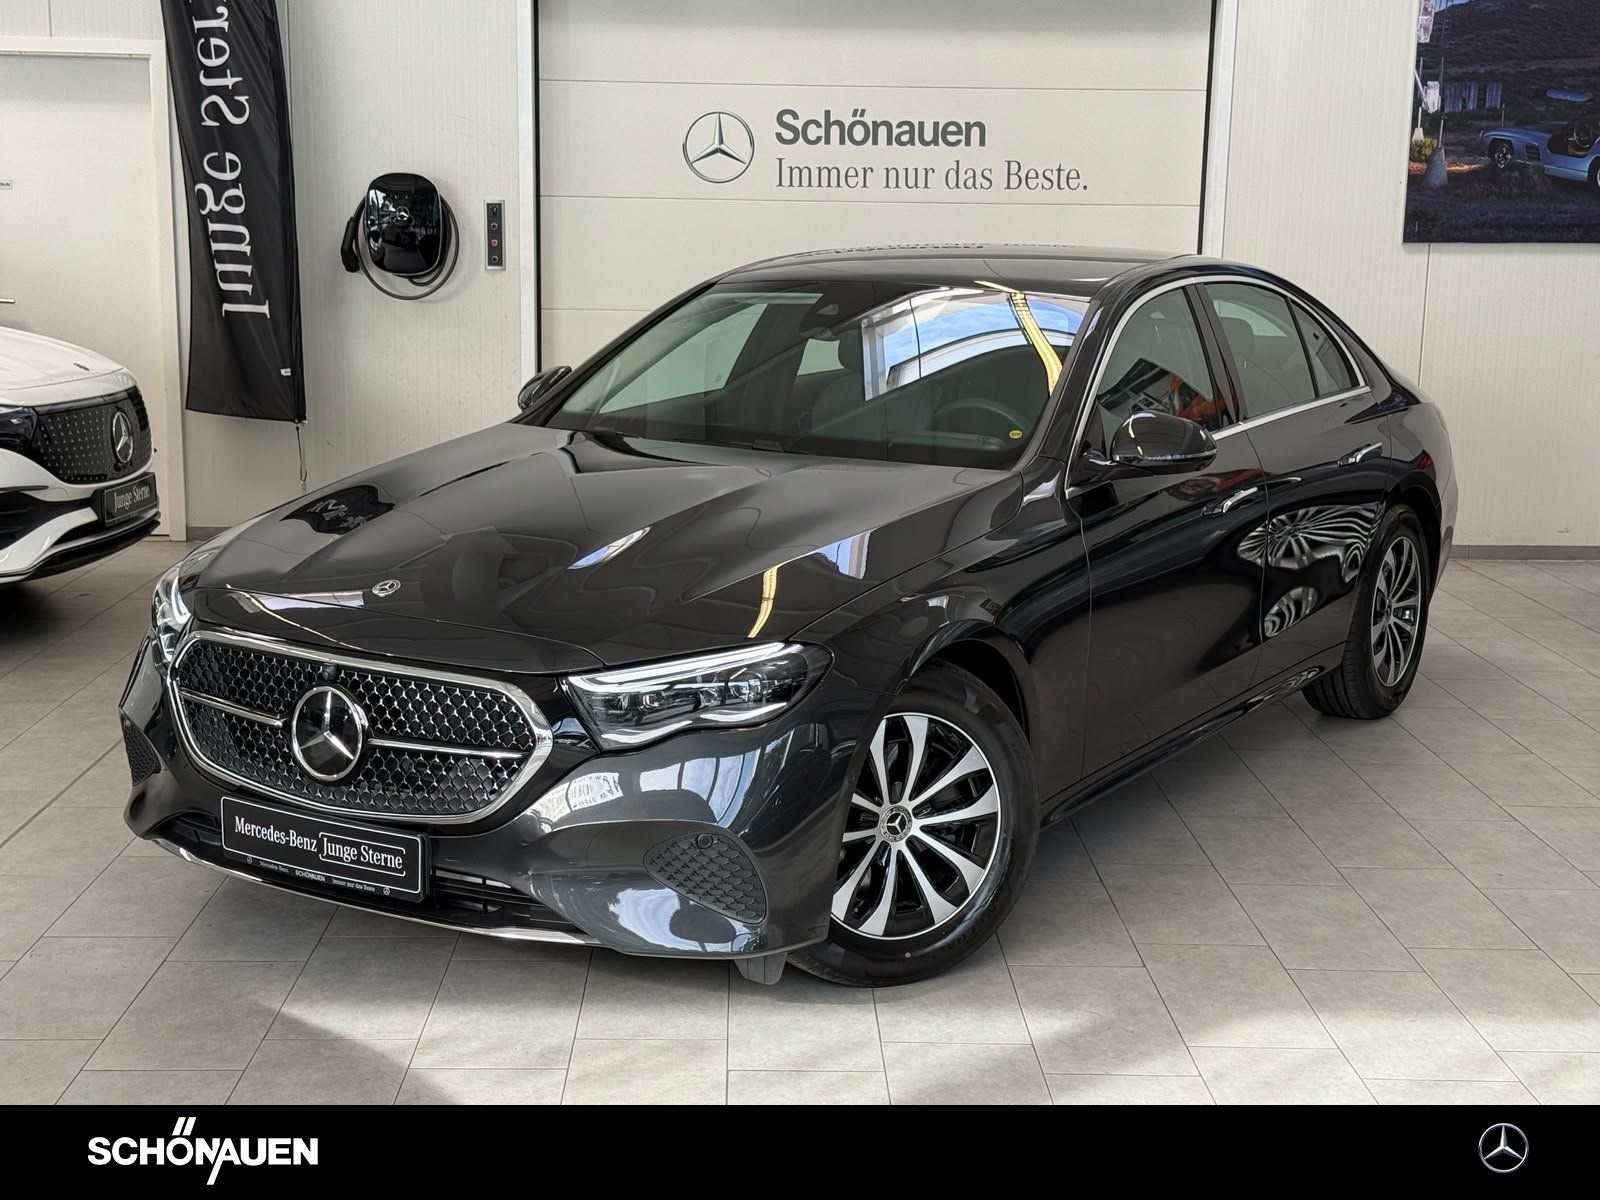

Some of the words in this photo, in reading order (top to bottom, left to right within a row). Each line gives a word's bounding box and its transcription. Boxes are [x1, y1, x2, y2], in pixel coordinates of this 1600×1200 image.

[775, 108, 987, 147] Schönauen
[775, 157, 873, 189] Immer
[882, 164, 936, 190] nur
[944, 160, 993, 191] das
[1004, 159, 1088, 191] Beste.
[114, 492, 132, 512] Junge
[133, 485, 150, 503] Sterne
[234, 816, 318, 852] Mercedes-Benz
[322, 837, 358, 862] Junge
[360, 845, 403, 869] Sterne
